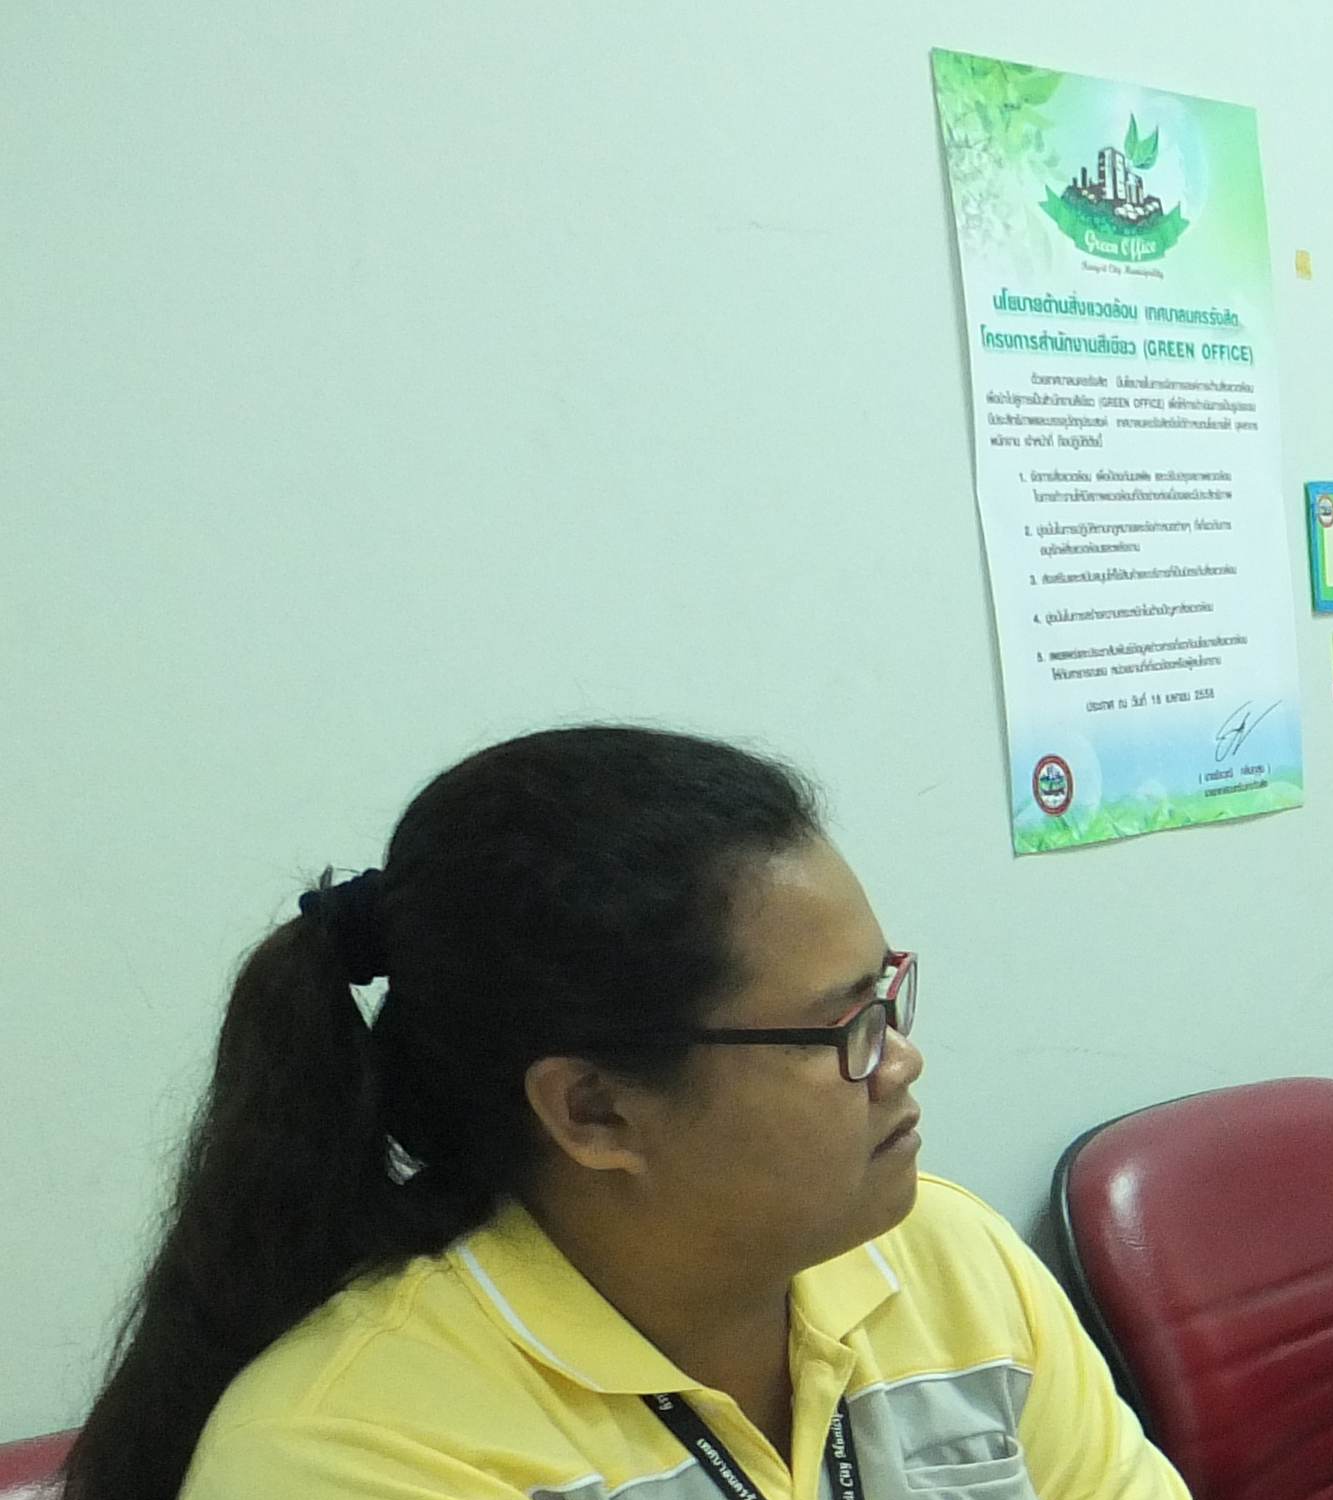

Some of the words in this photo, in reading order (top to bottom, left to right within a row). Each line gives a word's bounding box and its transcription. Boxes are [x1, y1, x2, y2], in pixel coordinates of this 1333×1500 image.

[1085, 229, 1118, 254] Green
[1143, 339, 1195, 360] (GREEN
[1202, 343, 1254, 365] OFFICE)
[838, 1460, 855, 1489] City
